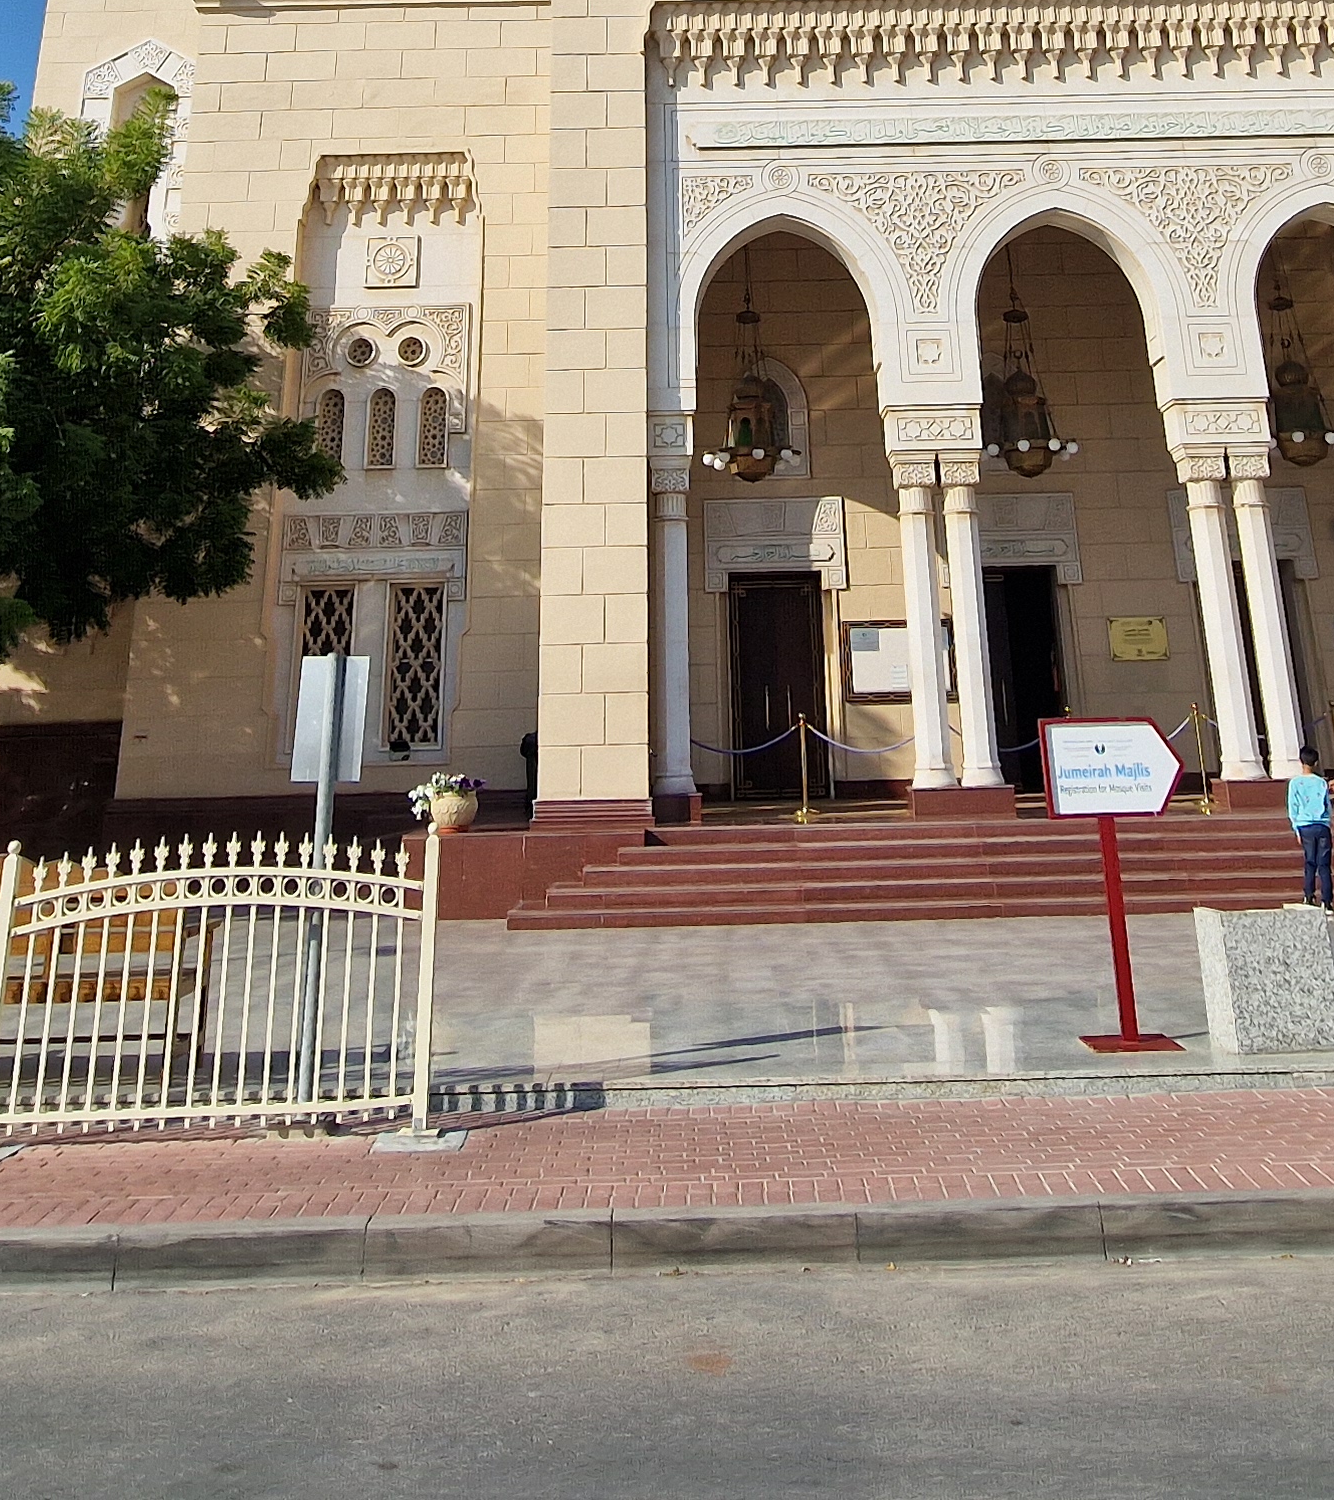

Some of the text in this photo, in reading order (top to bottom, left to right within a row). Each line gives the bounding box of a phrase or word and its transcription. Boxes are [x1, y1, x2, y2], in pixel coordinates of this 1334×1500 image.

[1058, 762, 1151, 781] Jumeirah Majlis
[1060, 783, 1153, 797] Registration for Mosque Visits
